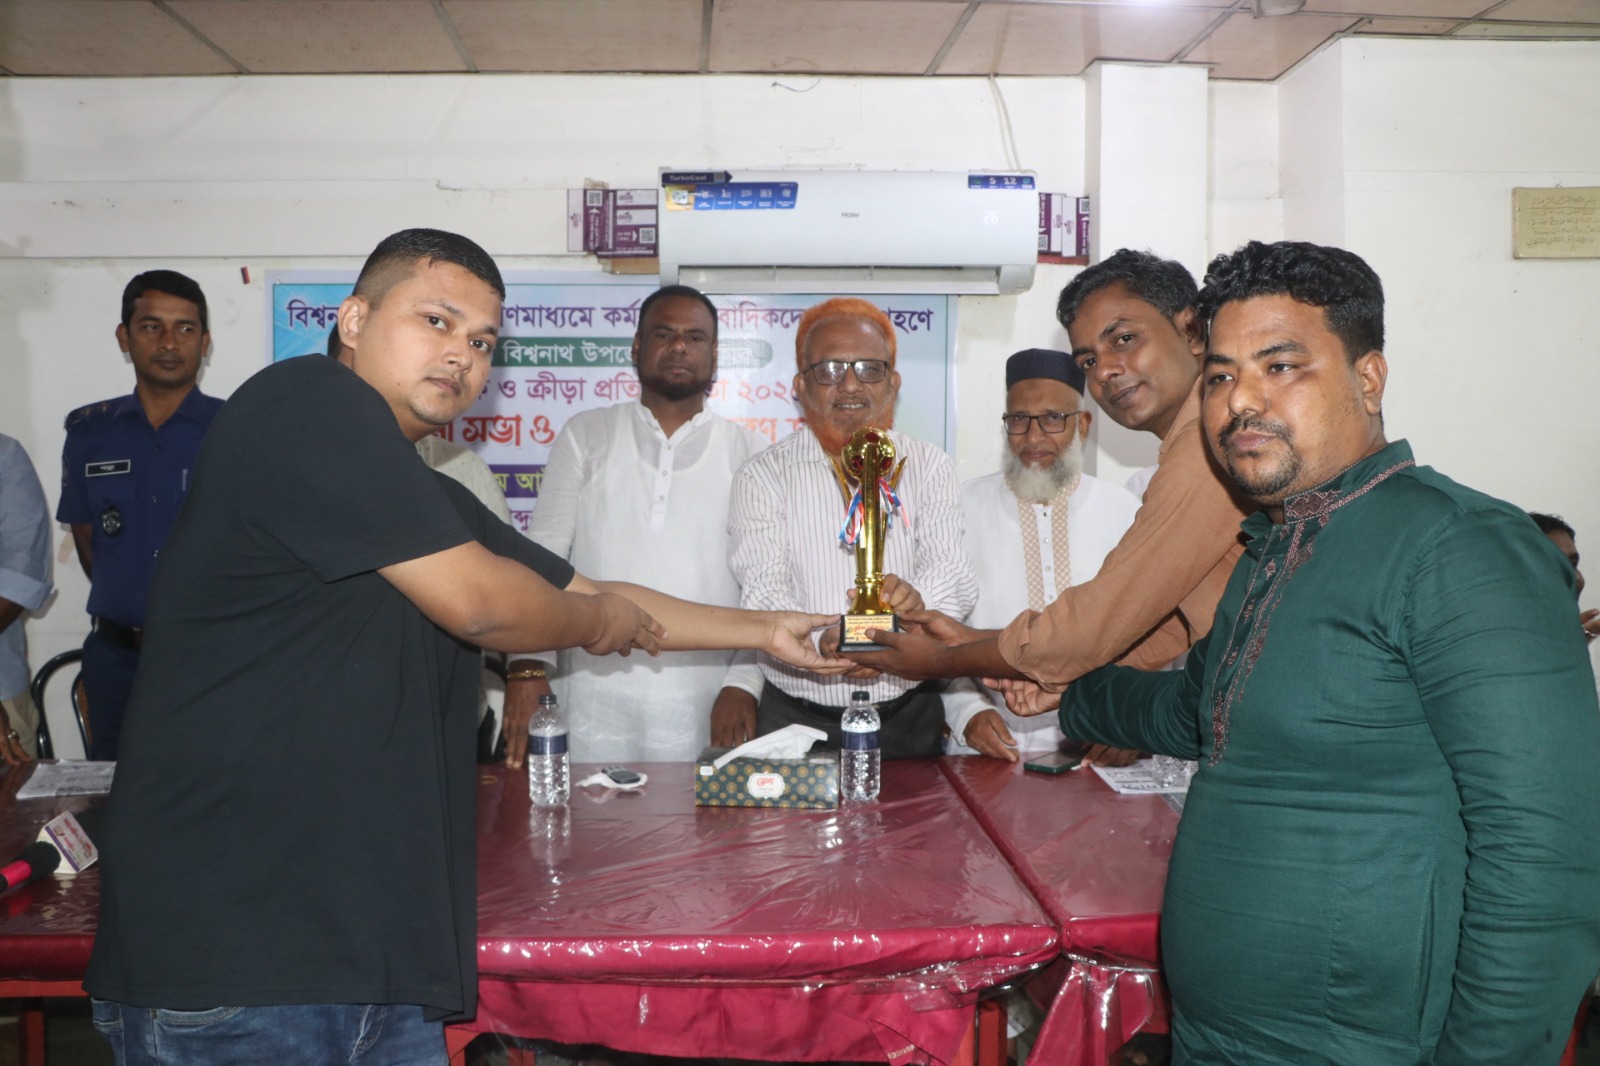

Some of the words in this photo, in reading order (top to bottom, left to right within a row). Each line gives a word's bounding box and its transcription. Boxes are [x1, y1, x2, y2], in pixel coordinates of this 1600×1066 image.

[669, 174, 707, 182] TurboCool
[989, 177, 997, 185] 5
[1003, 177, 1017, 185] 12
[983, 210, 999, 225] 26
[286, 298, 339, 329] বিশ্বন
[601, 298, 641, 328] কর্ম
[716, 300, 806, 329] বাদিকদে
[882, 306, 935, 334] হণে
[502, 340, 576, 364] বিশ্বনাথ
[498, 380, 517, 399] ও
[525, 371, 587, 405] ক্রীড়া
[593, 372, 641, 401] প্রতি
[462, 414, 522, 447] সভা
[529, 414, 556, 445] ও
